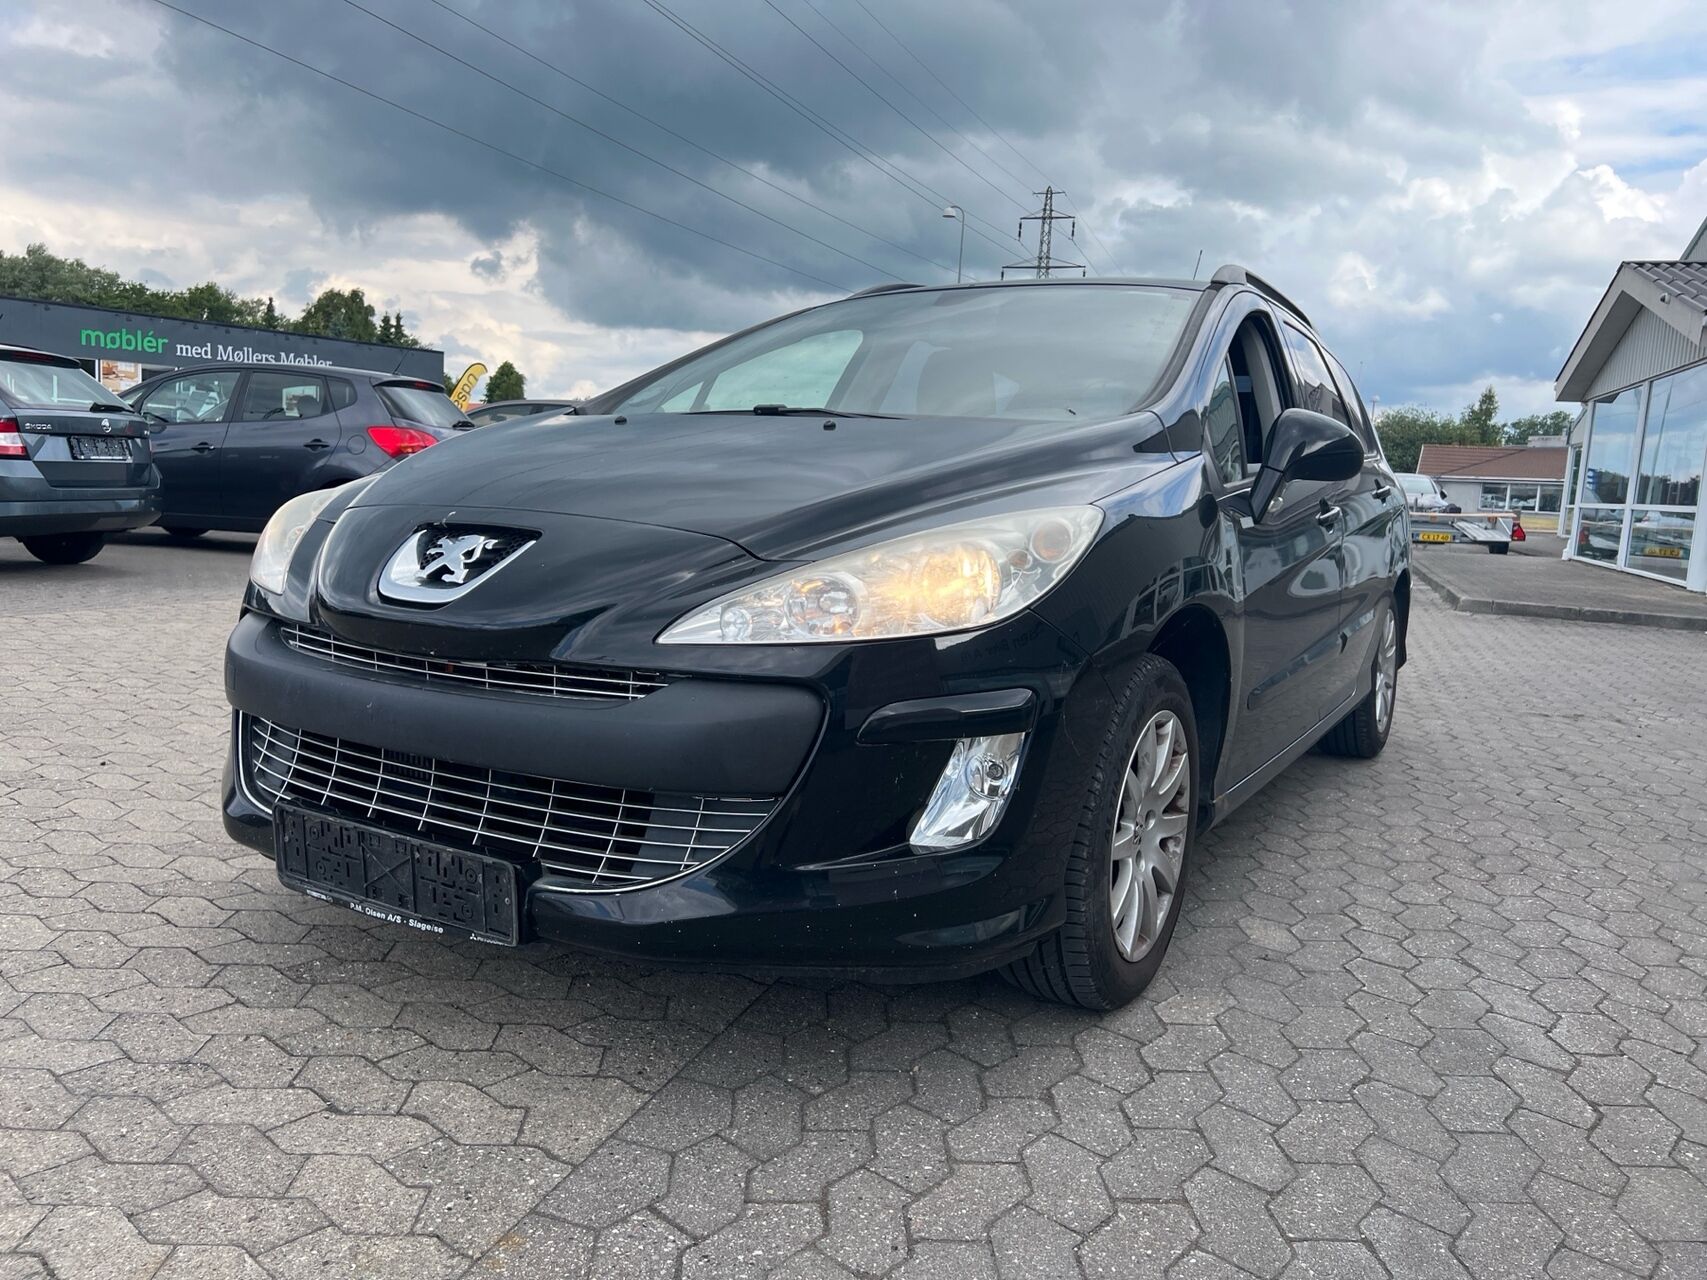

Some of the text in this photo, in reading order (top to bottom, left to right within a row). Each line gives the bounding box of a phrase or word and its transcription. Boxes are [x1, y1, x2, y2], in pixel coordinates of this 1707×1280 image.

[79, 328, 168, 353] møblér
[175, 343, 212, 359] med
[216, 345, 276, 364] Møllers
[349, 902, 364, 913] P.M.
[365, 907, 386, 920] Olsen
[387, 913, 402, 924] A/S
